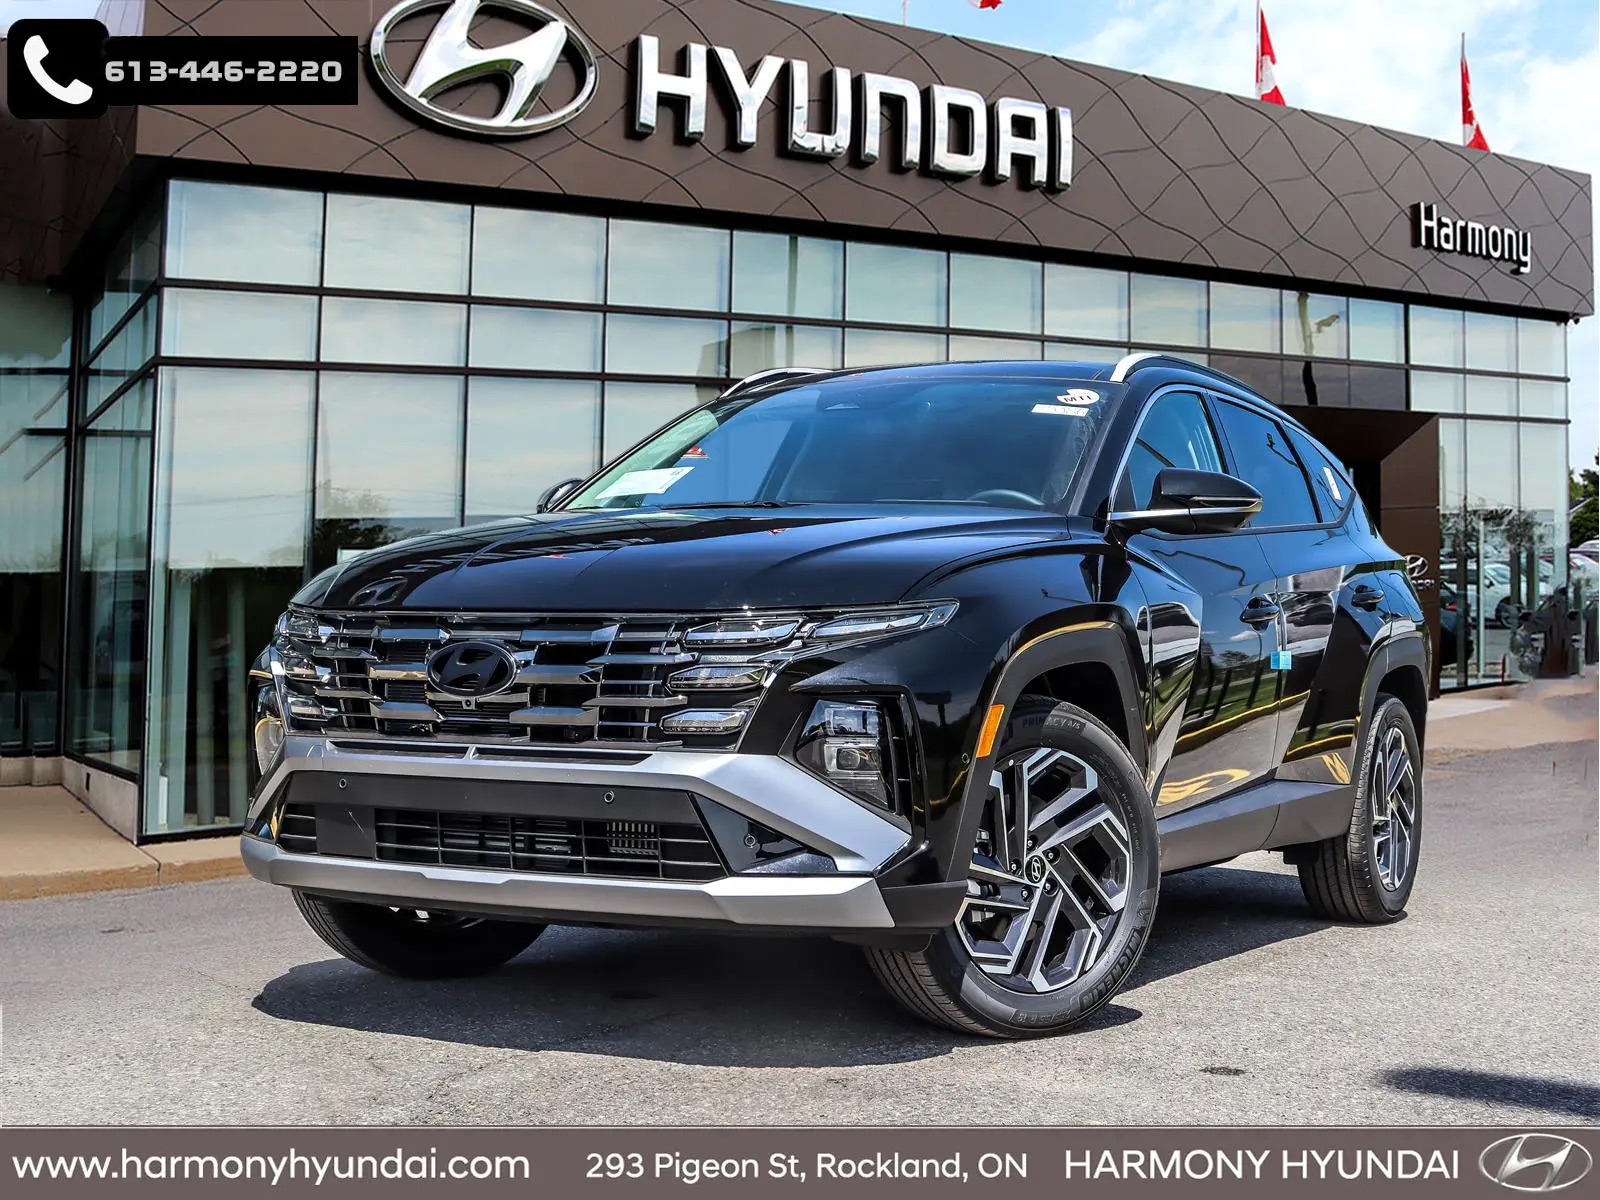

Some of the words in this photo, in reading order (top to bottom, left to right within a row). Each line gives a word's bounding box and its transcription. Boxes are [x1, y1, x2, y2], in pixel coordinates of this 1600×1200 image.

[635, 34, 1073, 191] HYUNDAI
[1414, 201, 1532, 274] Harmony
[1081, 931, 1141, 1009] MICHELIN
